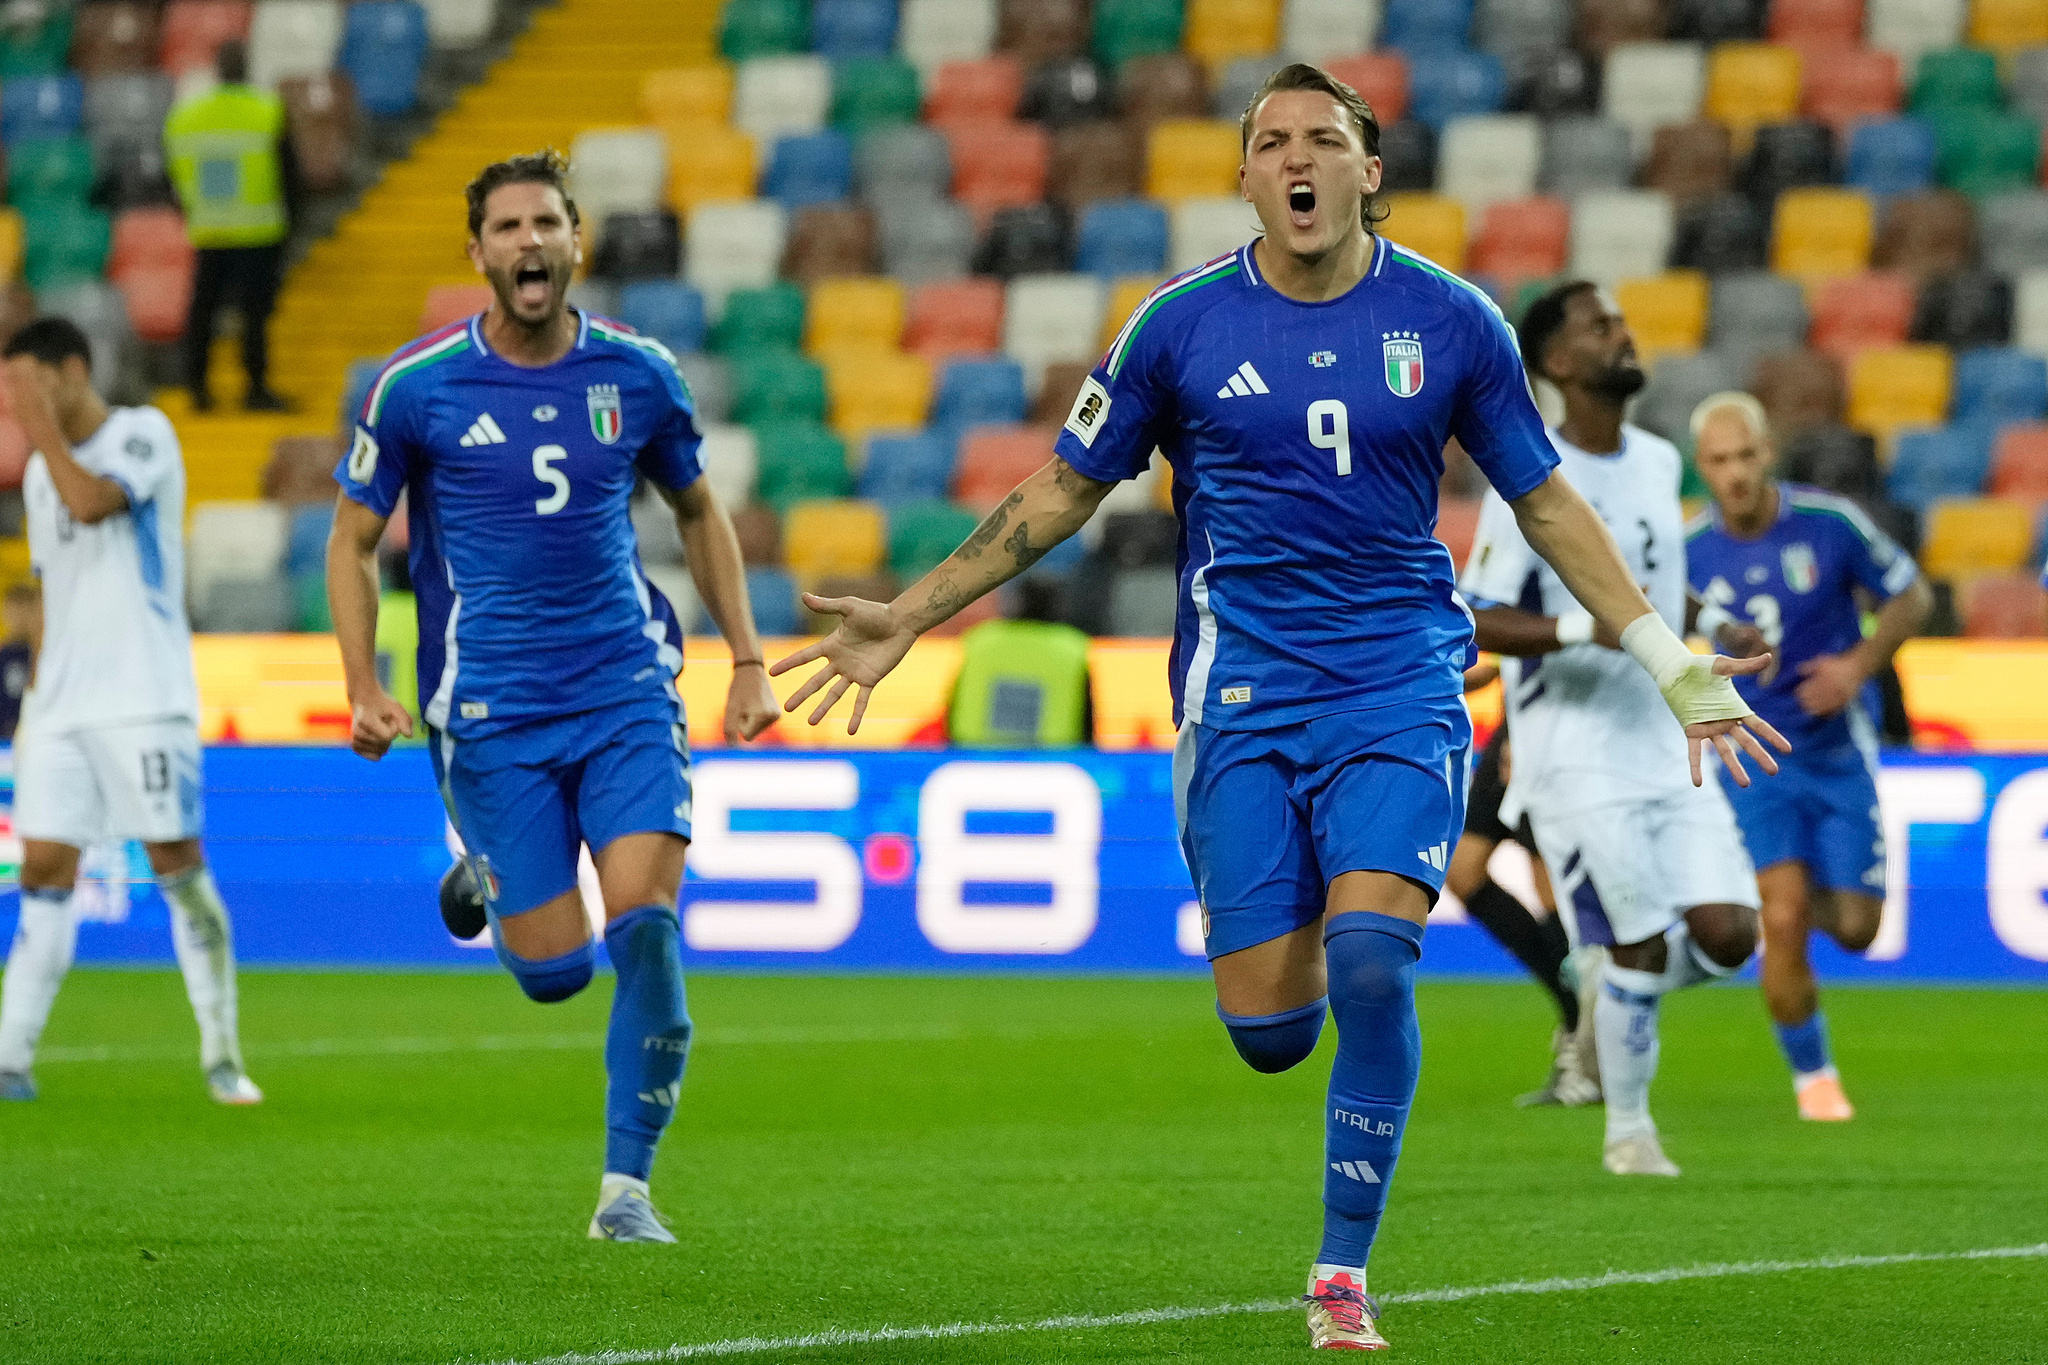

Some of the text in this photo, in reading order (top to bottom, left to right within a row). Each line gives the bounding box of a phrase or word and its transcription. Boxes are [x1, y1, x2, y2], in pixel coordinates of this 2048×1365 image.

[1386, 344, 1419, 357] ITALIA
[1307, 399, 1352, 476] 9
[532, 444, 570, 515] 5
[1636, 518, 1658, 571] 2
[1744, 594, 1784, 648] 3
[141, 748, 170, 794] 13
[1334, 1108, 1395, 1137] ITALIA
